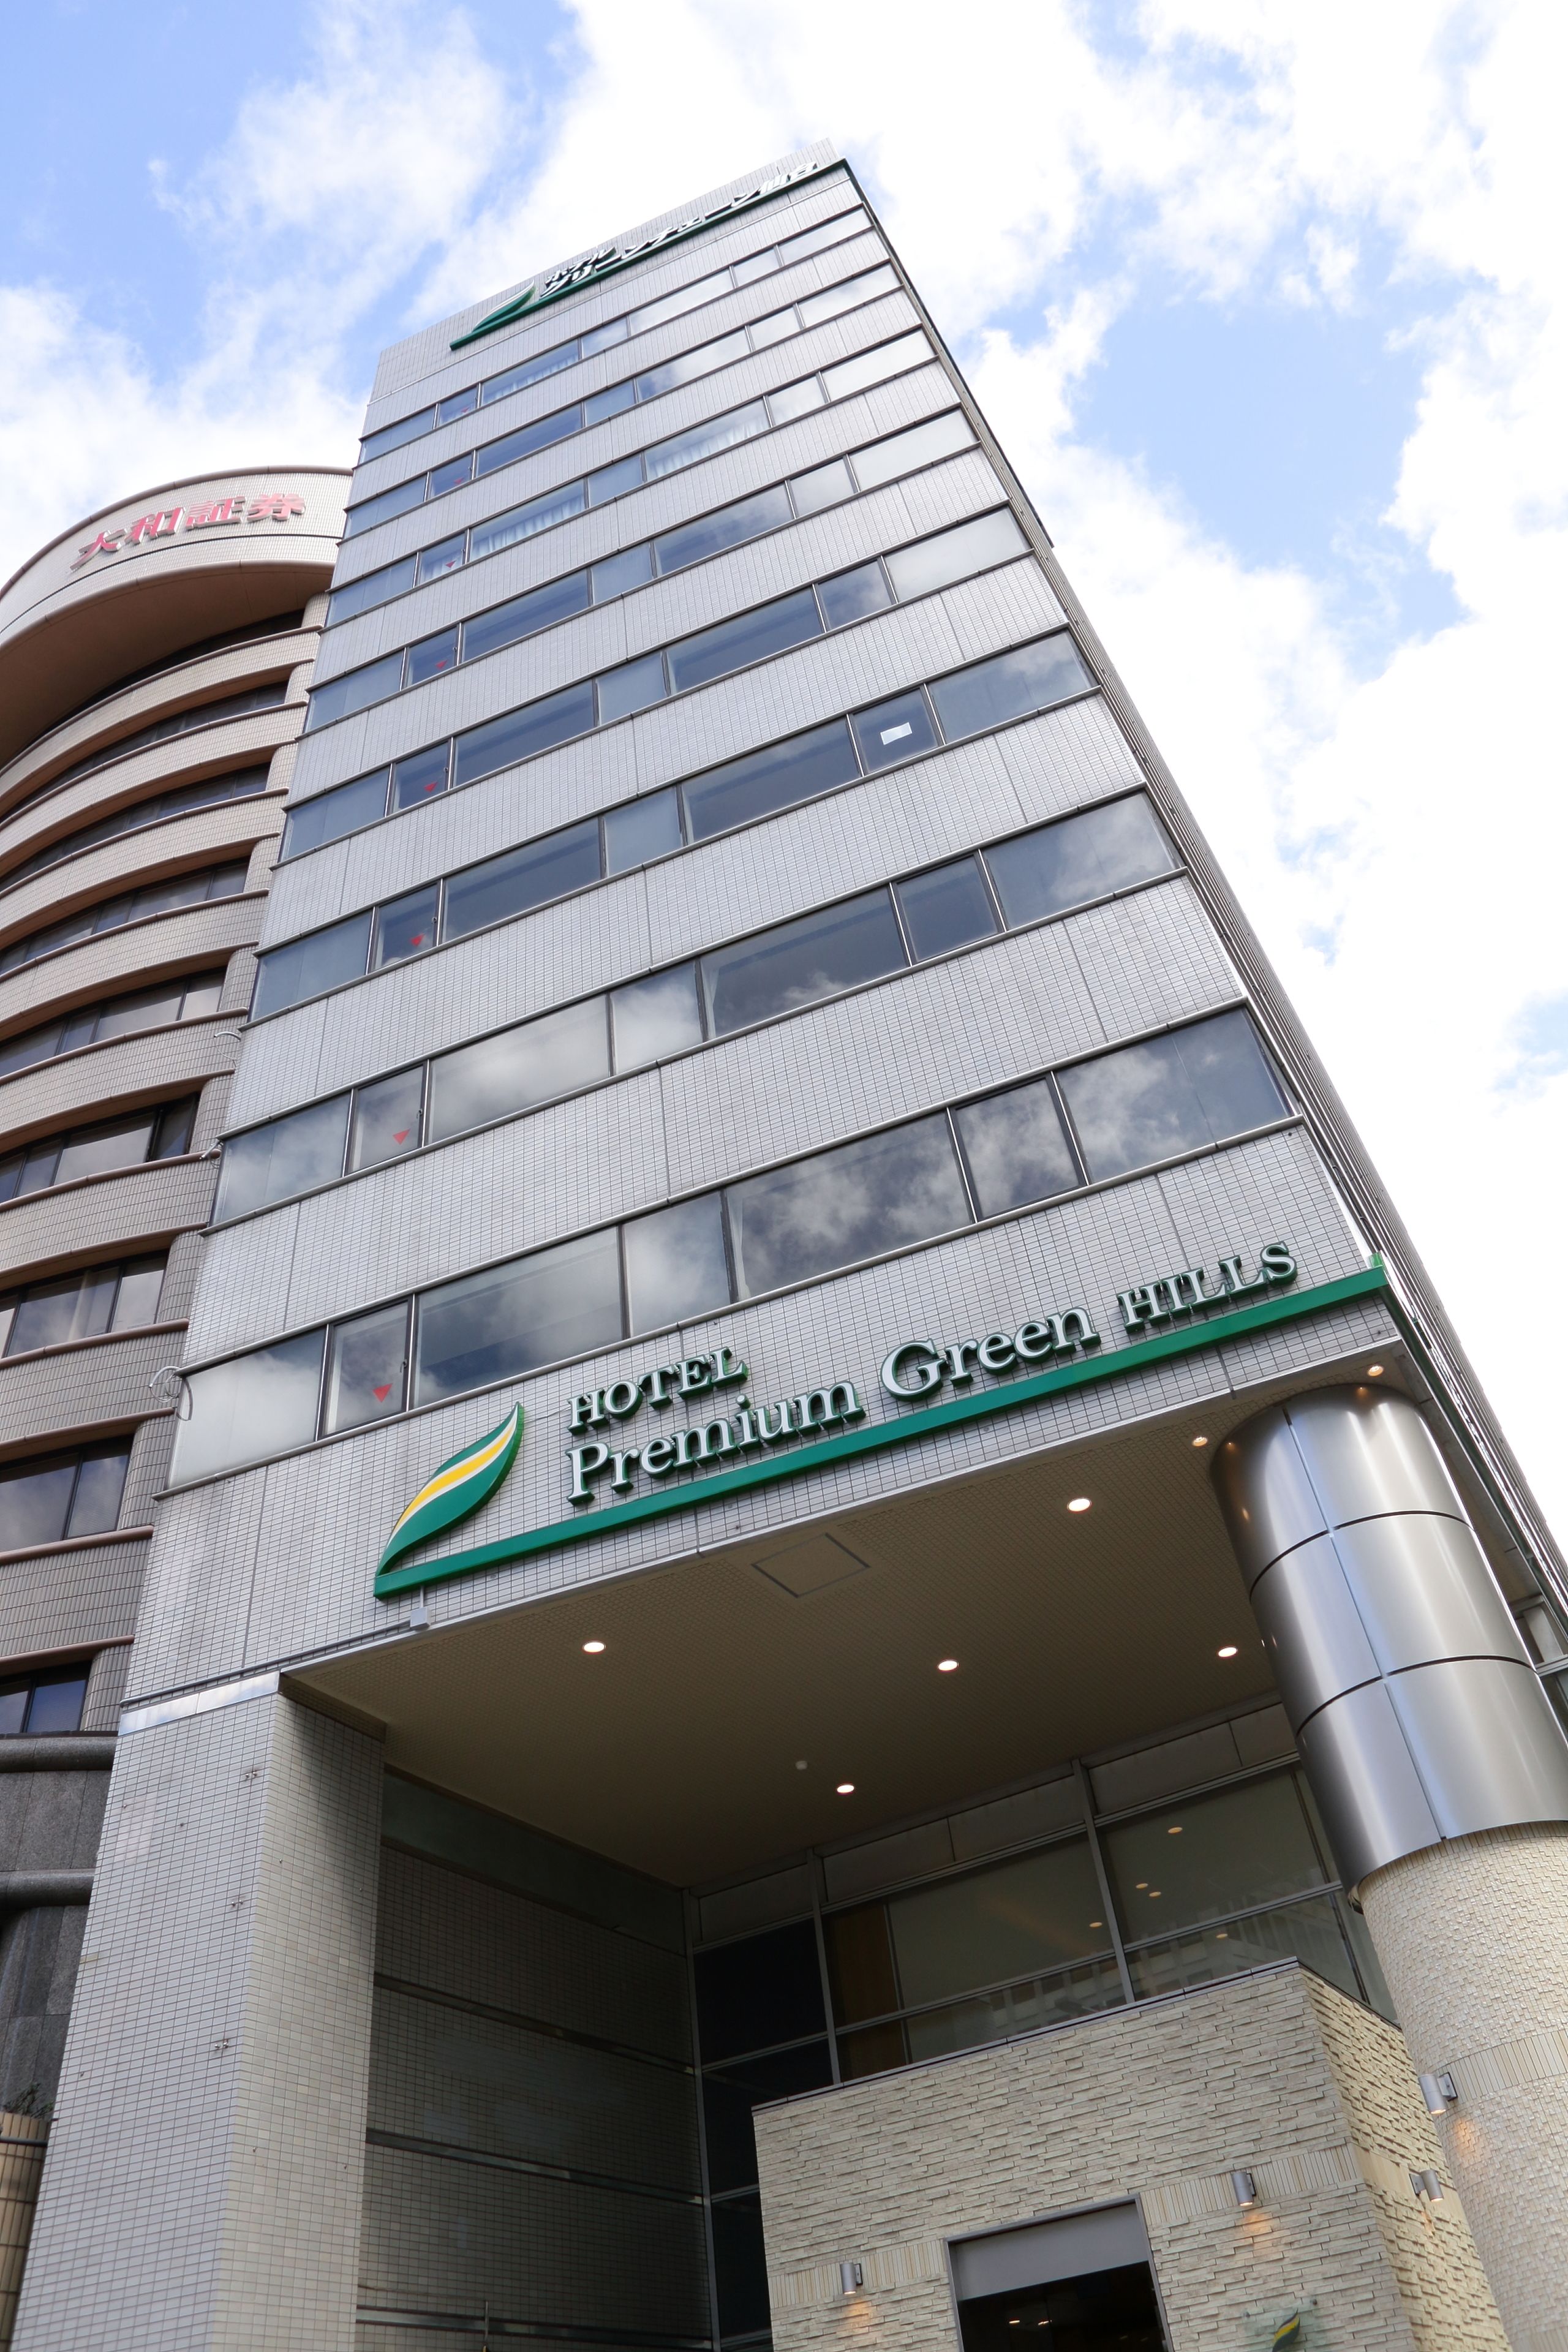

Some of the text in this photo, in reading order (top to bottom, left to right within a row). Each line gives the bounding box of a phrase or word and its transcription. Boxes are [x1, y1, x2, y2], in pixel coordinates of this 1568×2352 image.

[545, 246, 616, 284] ホテル
[69, 493, 306, 571] 大和証券
[565, 1240, 1298, 1506] Premium Green HILLS
[567, 1347, 749, 1434] HOTEL
